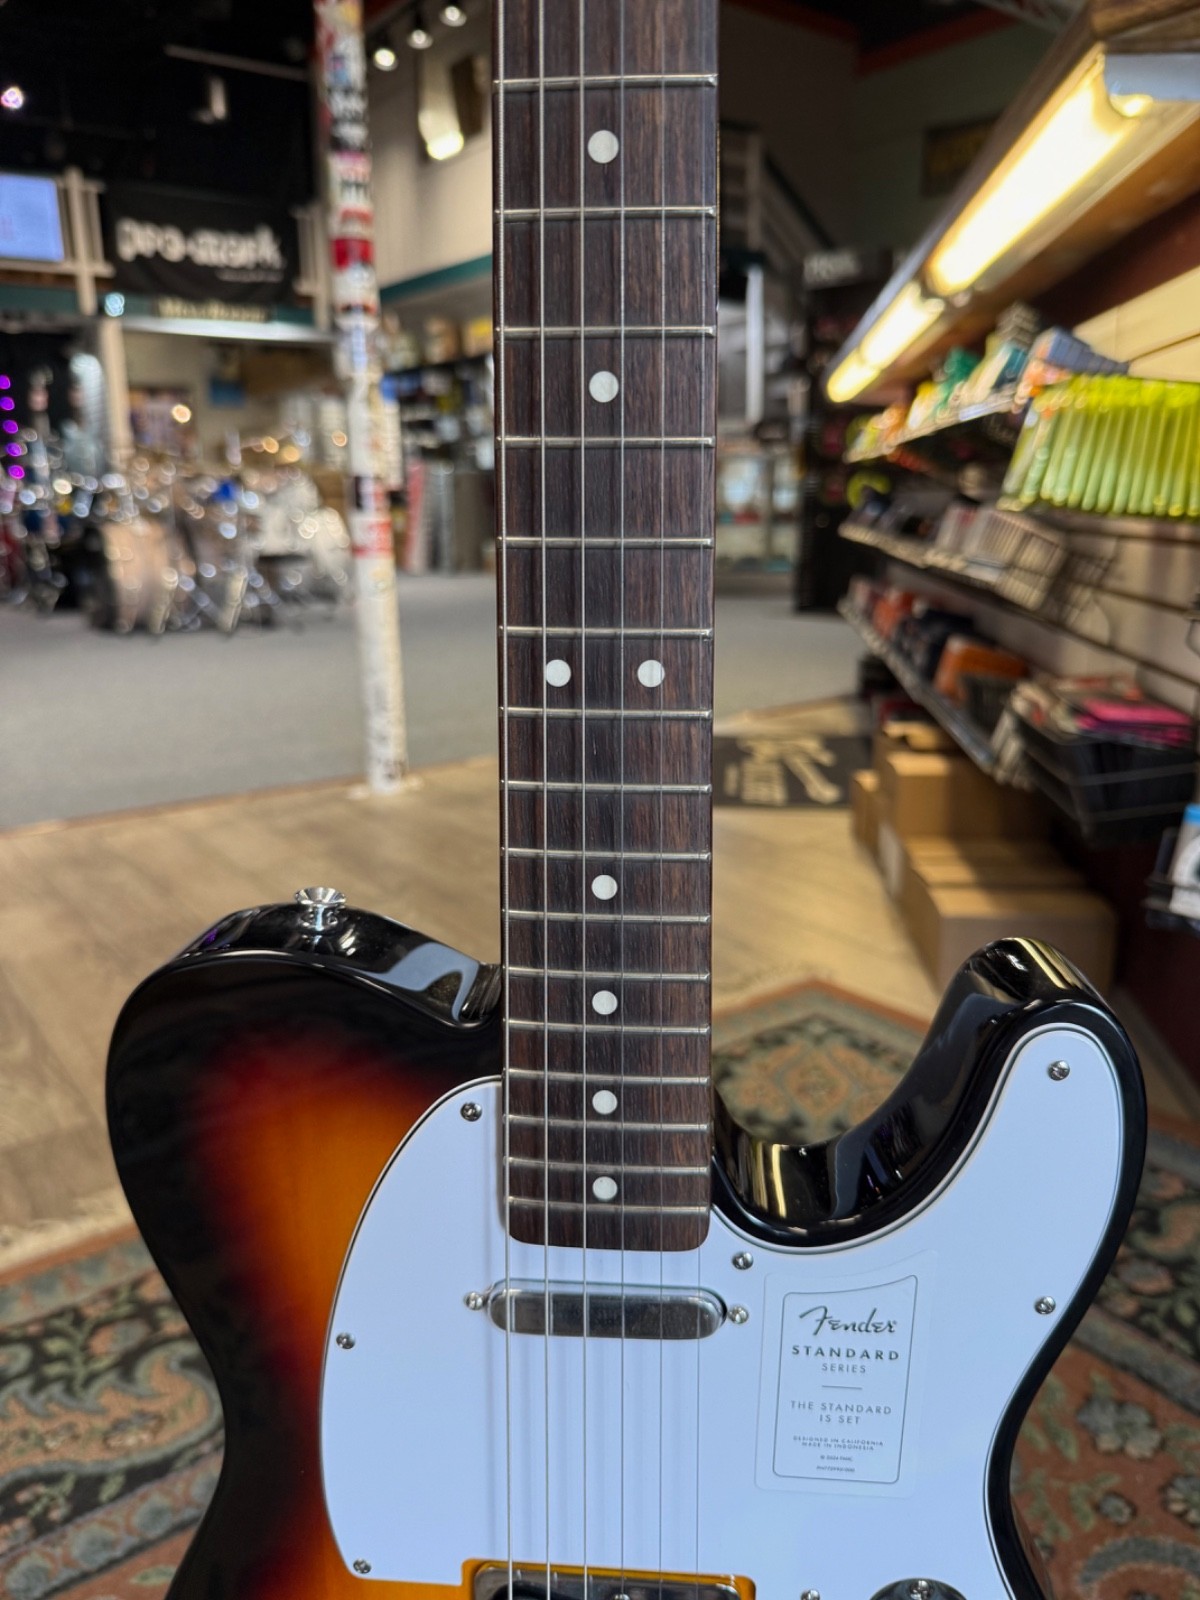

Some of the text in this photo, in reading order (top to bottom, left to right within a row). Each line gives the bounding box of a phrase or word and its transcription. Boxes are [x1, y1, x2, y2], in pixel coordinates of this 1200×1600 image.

[799, 1305, 896, 1336] Fender
[792, 1345, 900, 1361] STANDARD
[822, 1363, 867, 1374] SERIES
[791, 1400, 893, 1416] THE STANDARD
[819, 1414, 861, 1425] IS SET
[793, 1435, 829, 1443] DESIGNED
[841, 1438, 884, 1447] CALIFORNIA
[834, 1443, 875, 1451] INDONESIA
